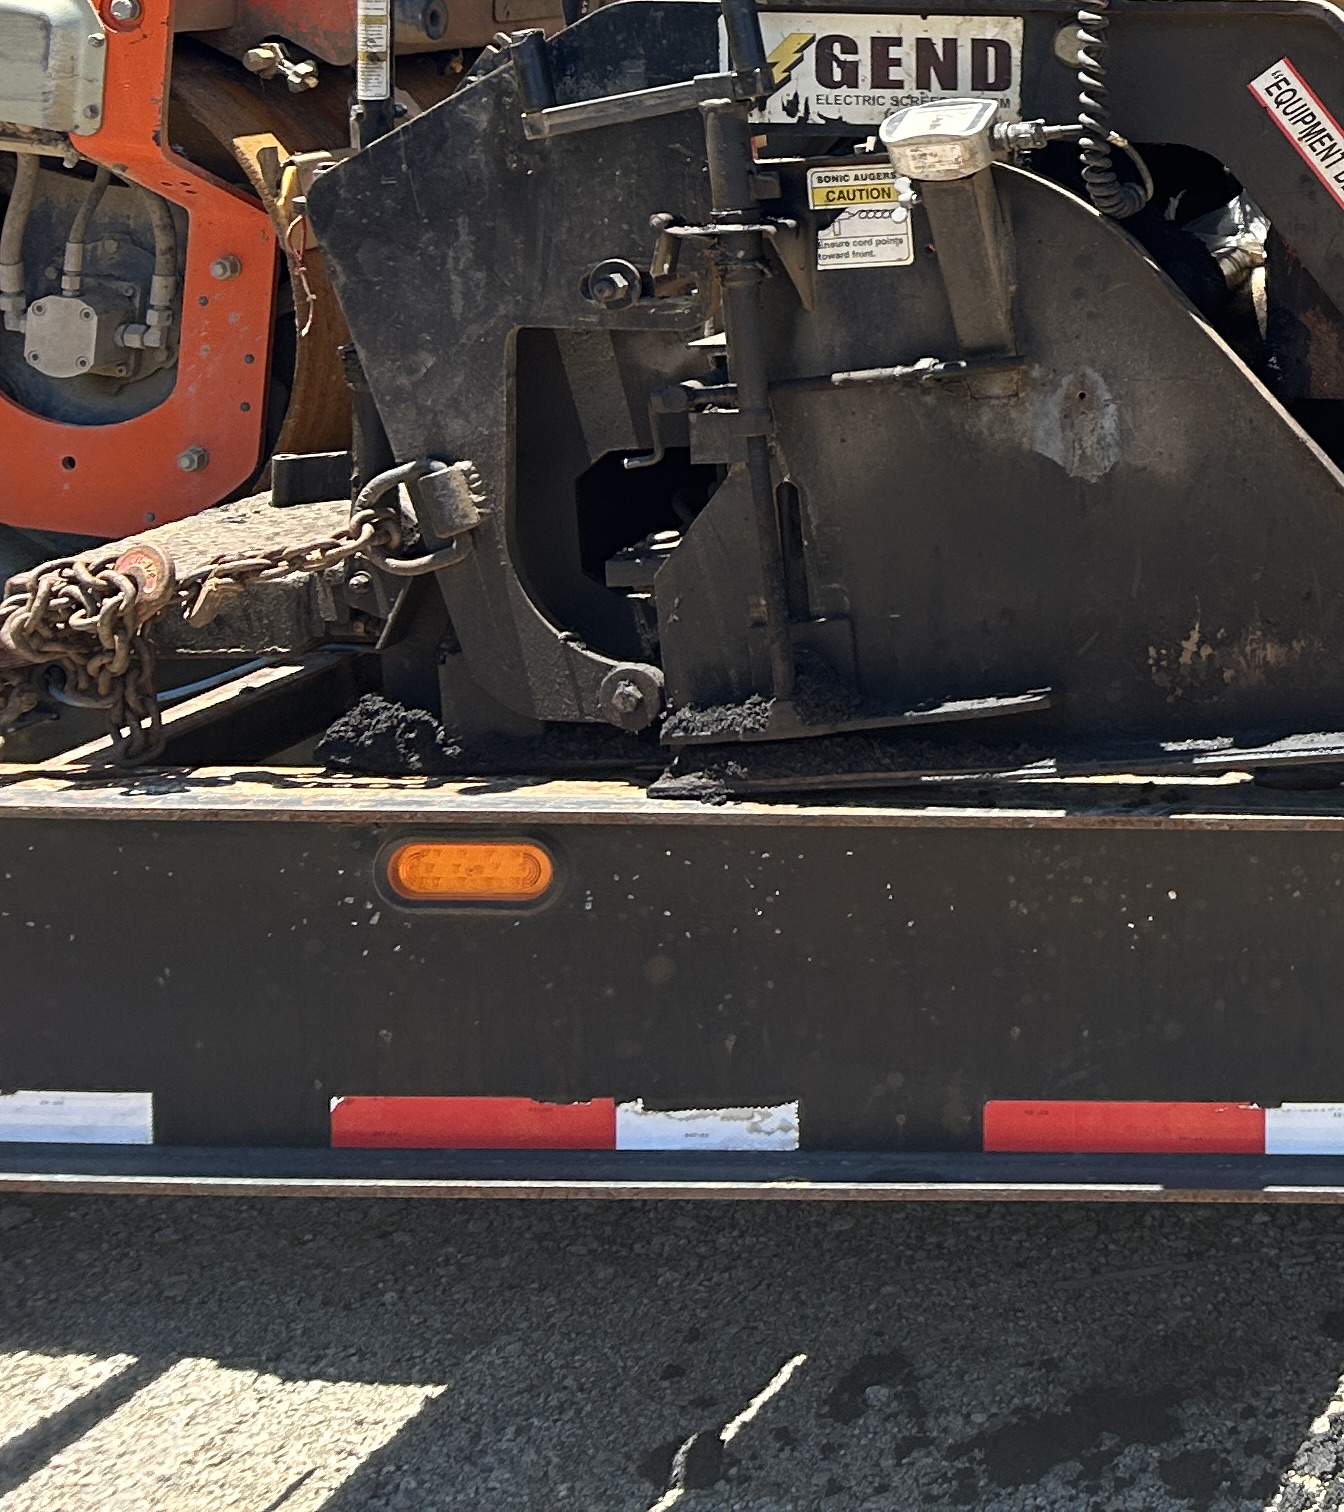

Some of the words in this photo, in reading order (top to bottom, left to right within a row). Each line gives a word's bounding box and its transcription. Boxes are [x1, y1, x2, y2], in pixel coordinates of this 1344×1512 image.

[816, 94, 885, 106] ELECTRIC
[816, 174, 850, 183] SONIC
[853, 171, 897, 182] AUGERS
[825, 187, 891, 203] CAUTION
